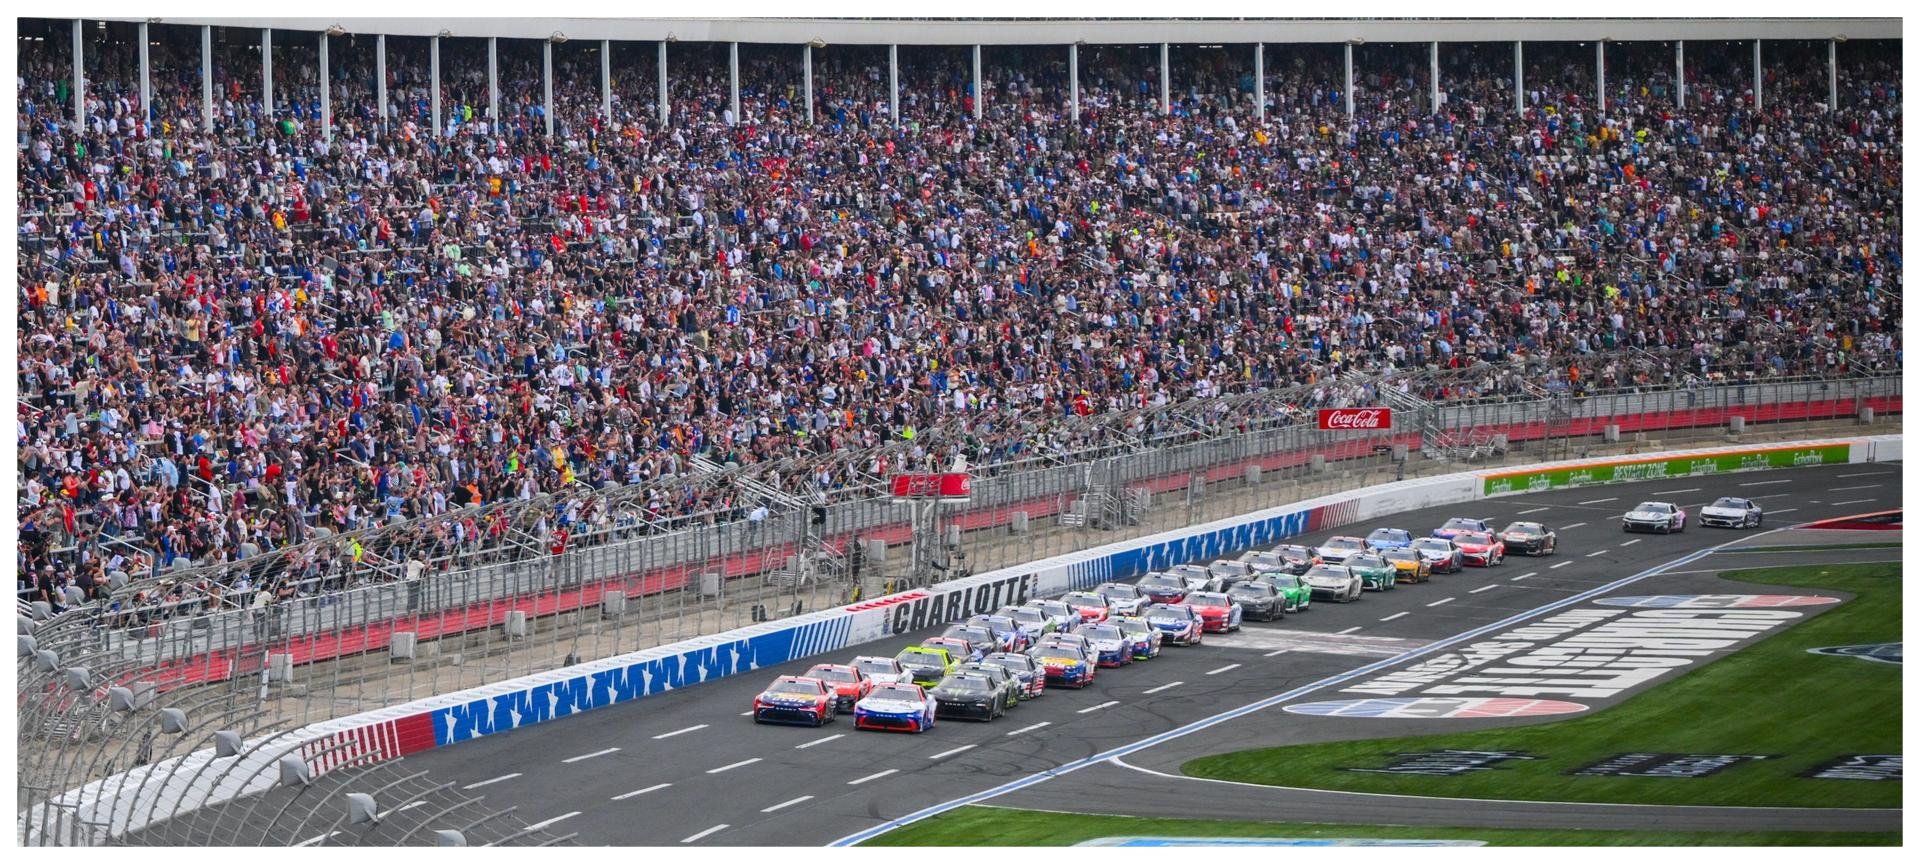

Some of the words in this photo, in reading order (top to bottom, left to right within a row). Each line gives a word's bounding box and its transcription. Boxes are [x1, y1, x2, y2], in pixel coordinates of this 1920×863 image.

[1327, 410, 1381, 428] Coca-Cola
[1613, 464, 1646, 480] RESTART
[1646, 461, 1669, 478] ZONE
[892, 574, 1031, 634] CHARLOTTE
